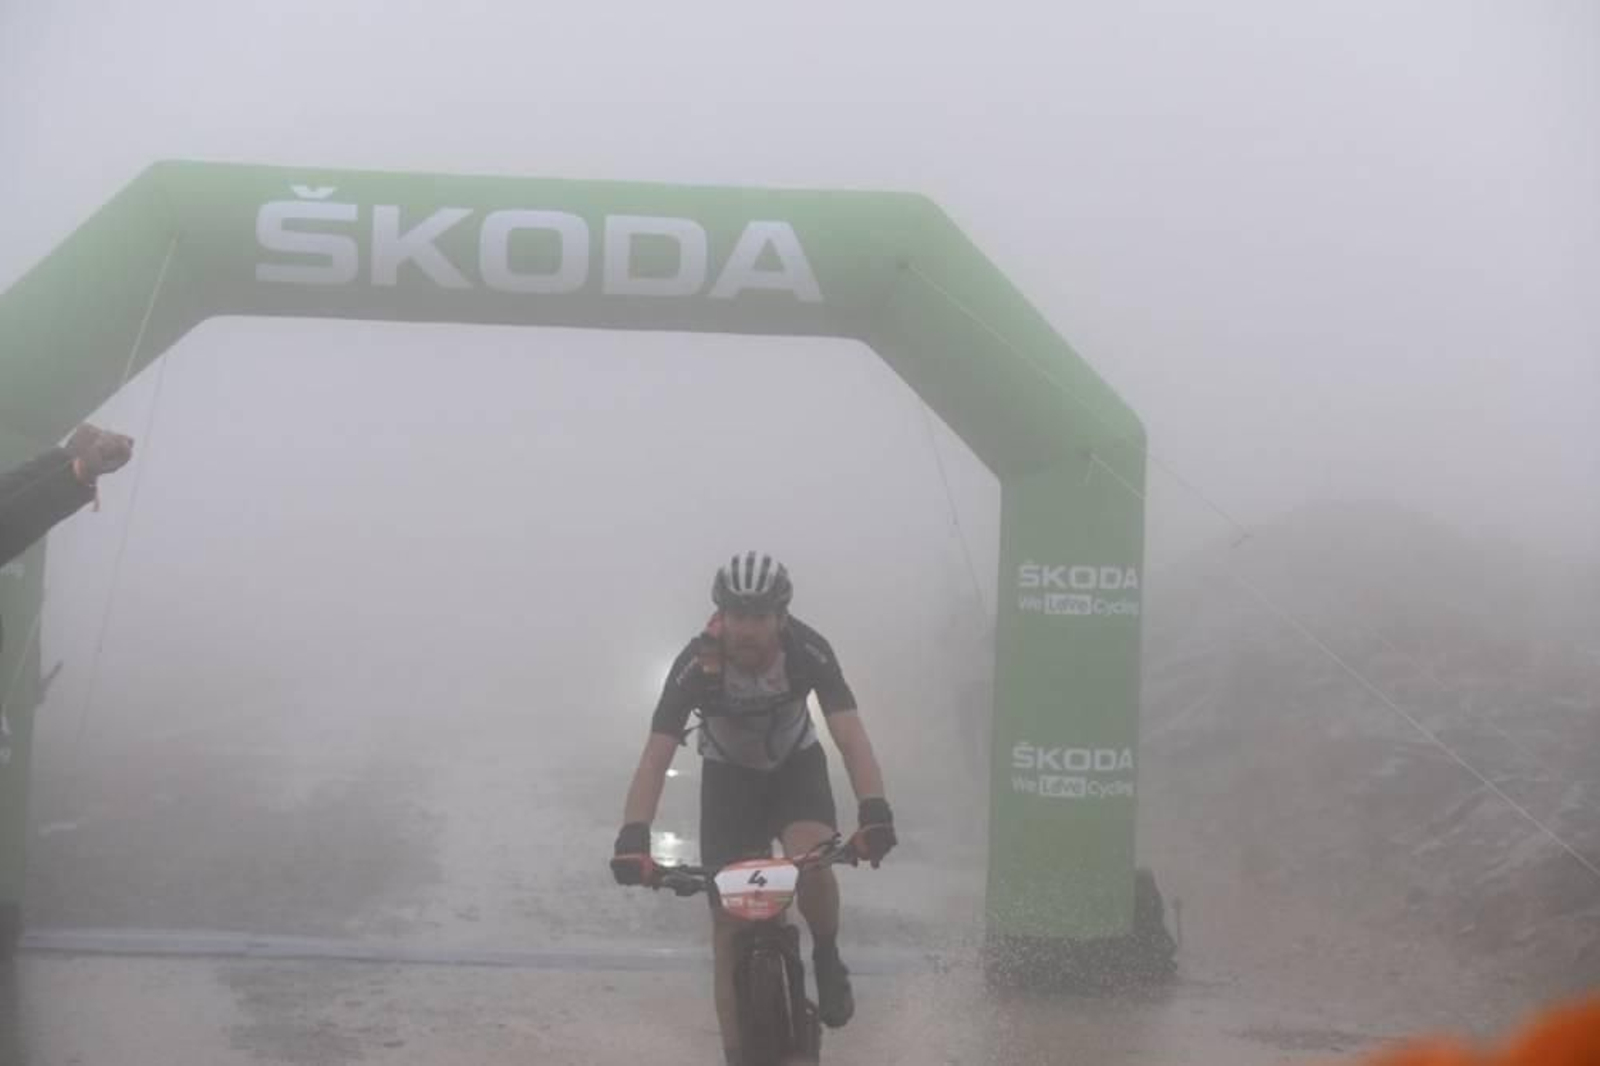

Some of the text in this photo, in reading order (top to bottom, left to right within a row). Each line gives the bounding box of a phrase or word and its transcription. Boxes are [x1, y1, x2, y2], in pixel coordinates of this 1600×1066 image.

[255, 184, 823, 301] ŠKODA
[1018, 559, 1139, 589] ŠKODA
[1011, 741, 1133, 771] ŠKODA
[747, 869, 769, 888] 4
